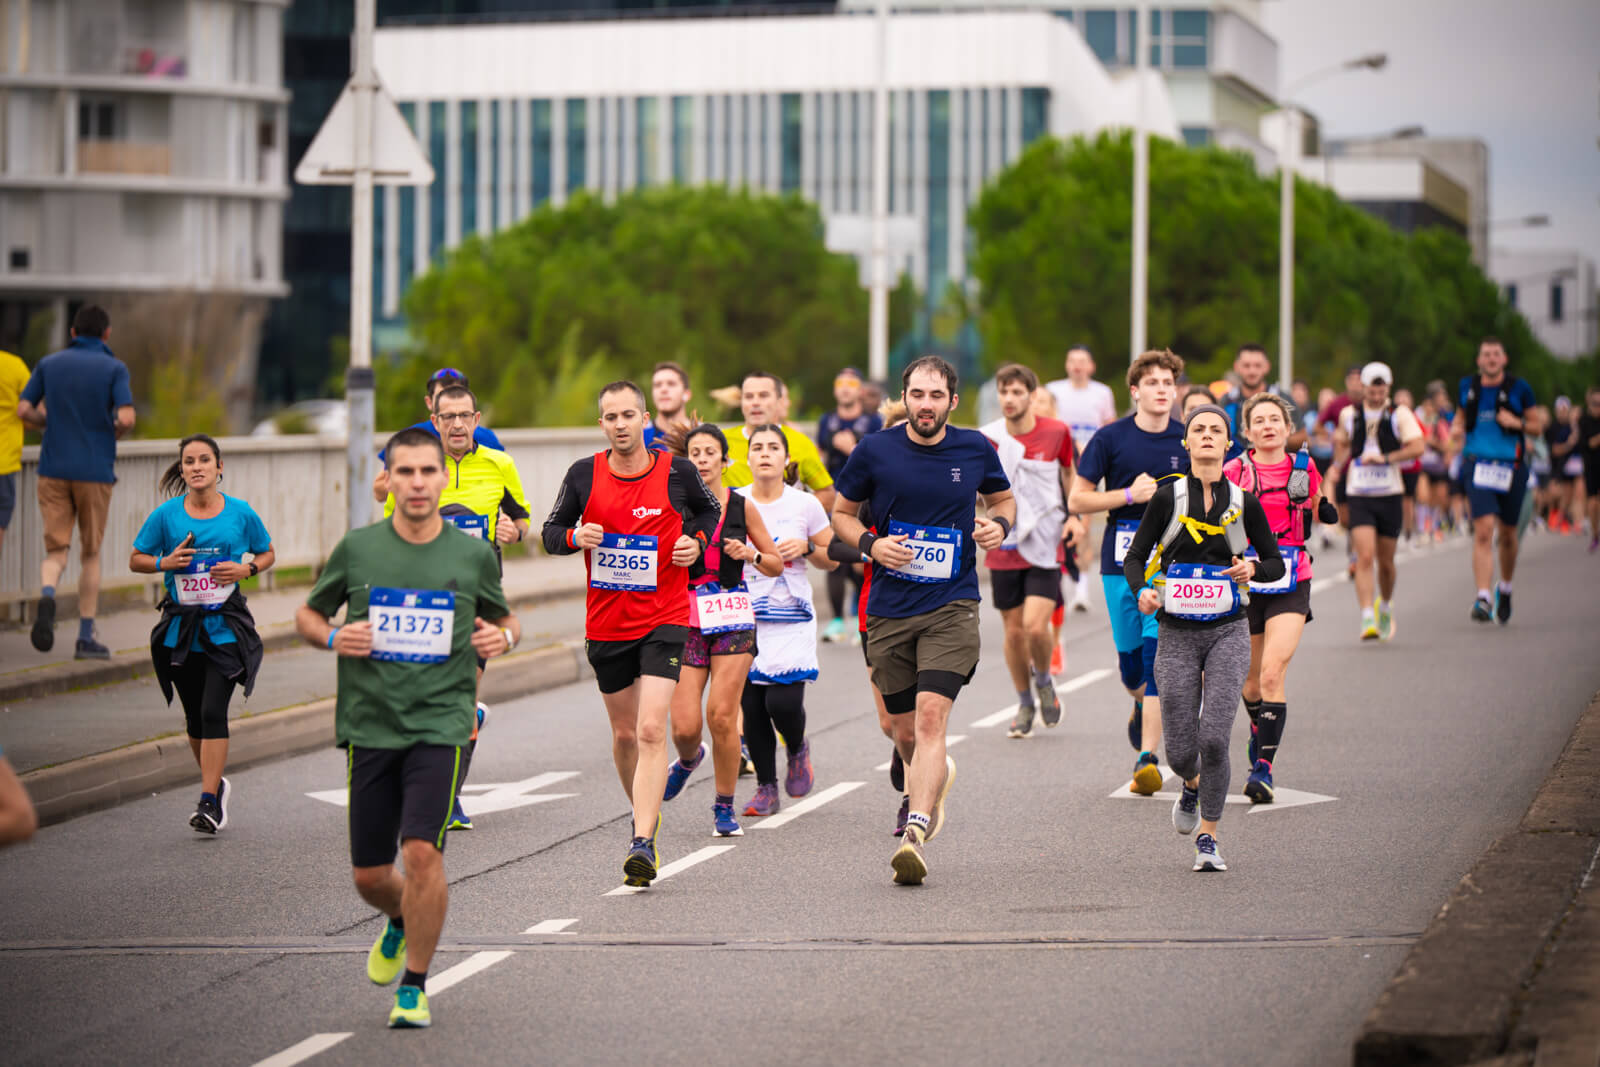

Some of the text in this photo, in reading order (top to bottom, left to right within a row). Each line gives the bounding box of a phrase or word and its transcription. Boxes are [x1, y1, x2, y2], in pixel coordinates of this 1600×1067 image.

[598, 552, 649, 571] 22365
[181, 577, 225, 592] 2205
[1173, 583, 1224, 599] 20937
[704, 596, 749, 613] 21439
[378, 613, 444, 635] 21373
